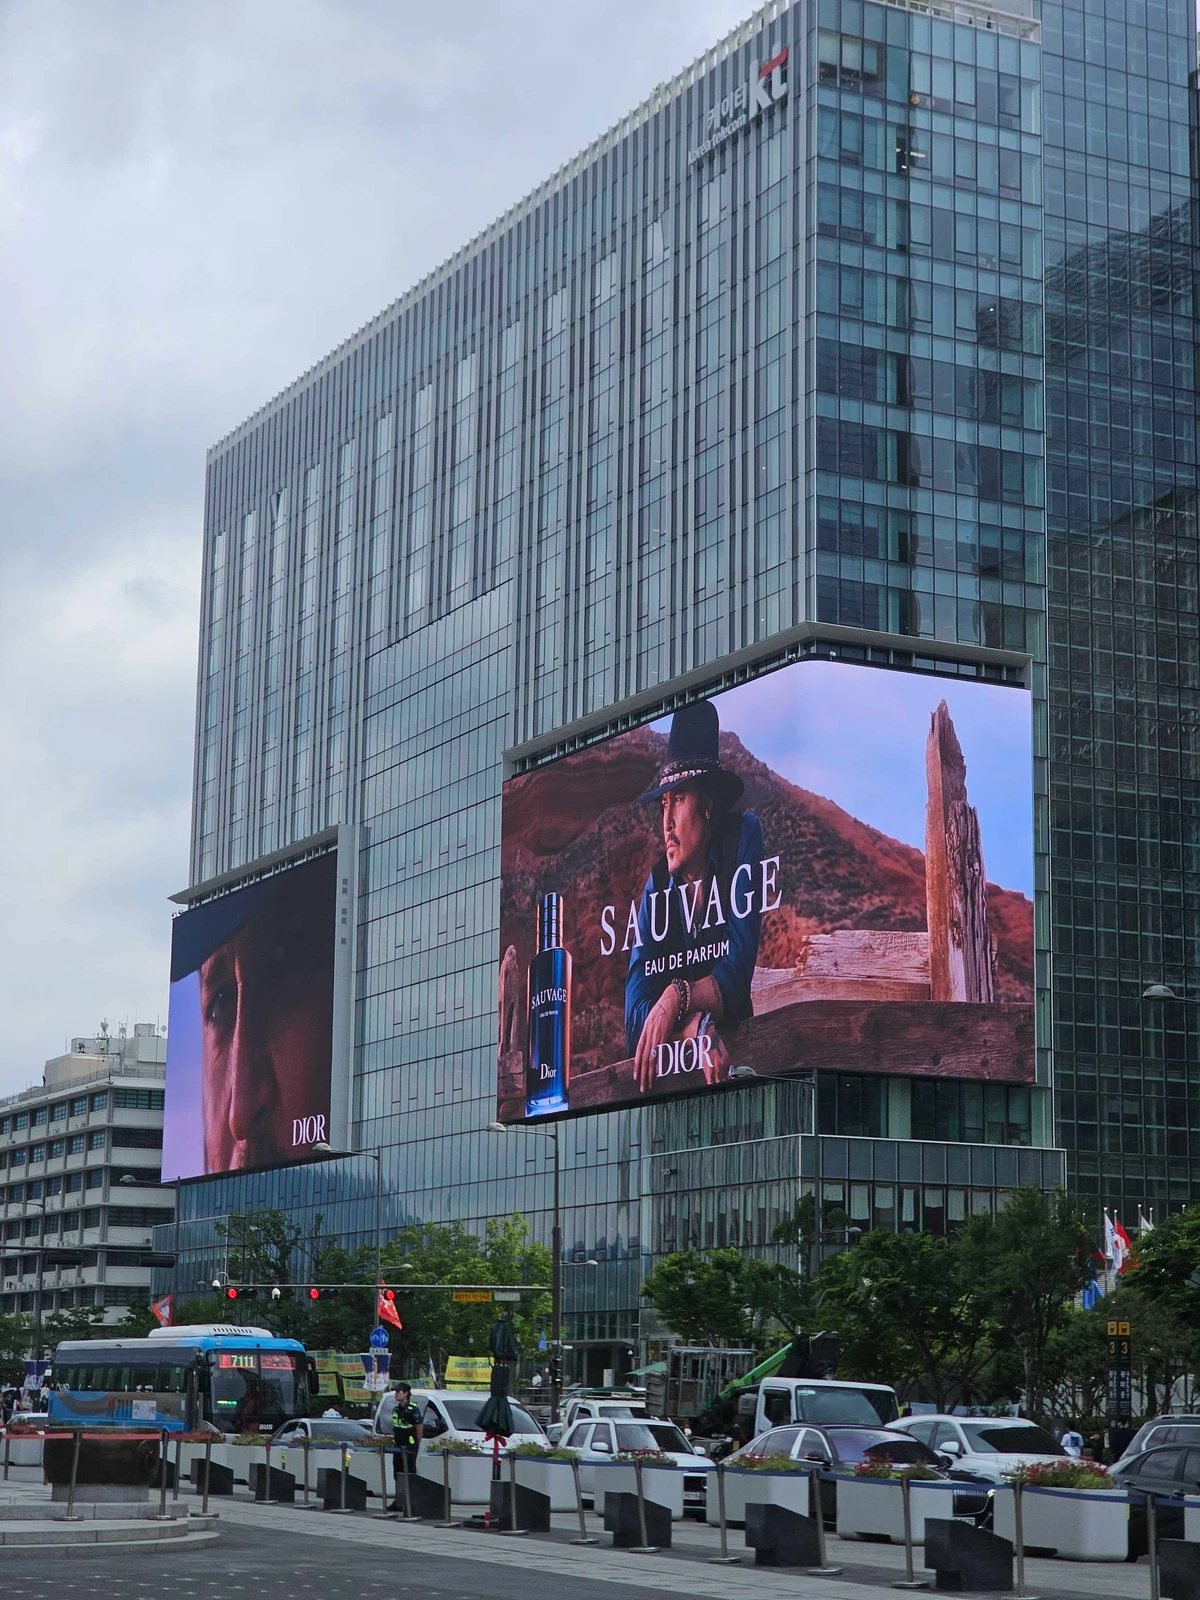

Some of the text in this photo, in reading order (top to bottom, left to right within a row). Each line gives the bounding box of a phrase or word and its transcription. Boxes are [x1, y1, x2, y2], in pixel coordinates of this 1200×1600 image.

[749, 41, 789, 121] kt
[708, 82, 747, 130] 케이티
[712, 113, 747, 147] telecom
[600, 855, 783, 956] SAUVAGE
[644, 940, 730, 977] EAU DE PARFUM
[531, 987, 567, 1010] SAUVAGE
[540, 1063, 557, 1080] Dior
[656, 1034, 714, 1078] DIOR
[291, 1114, 327, 1146] DIOR
[1109, 1341, 1115, 1354] 3
[1121, 1341, 1128, 1354] 3
